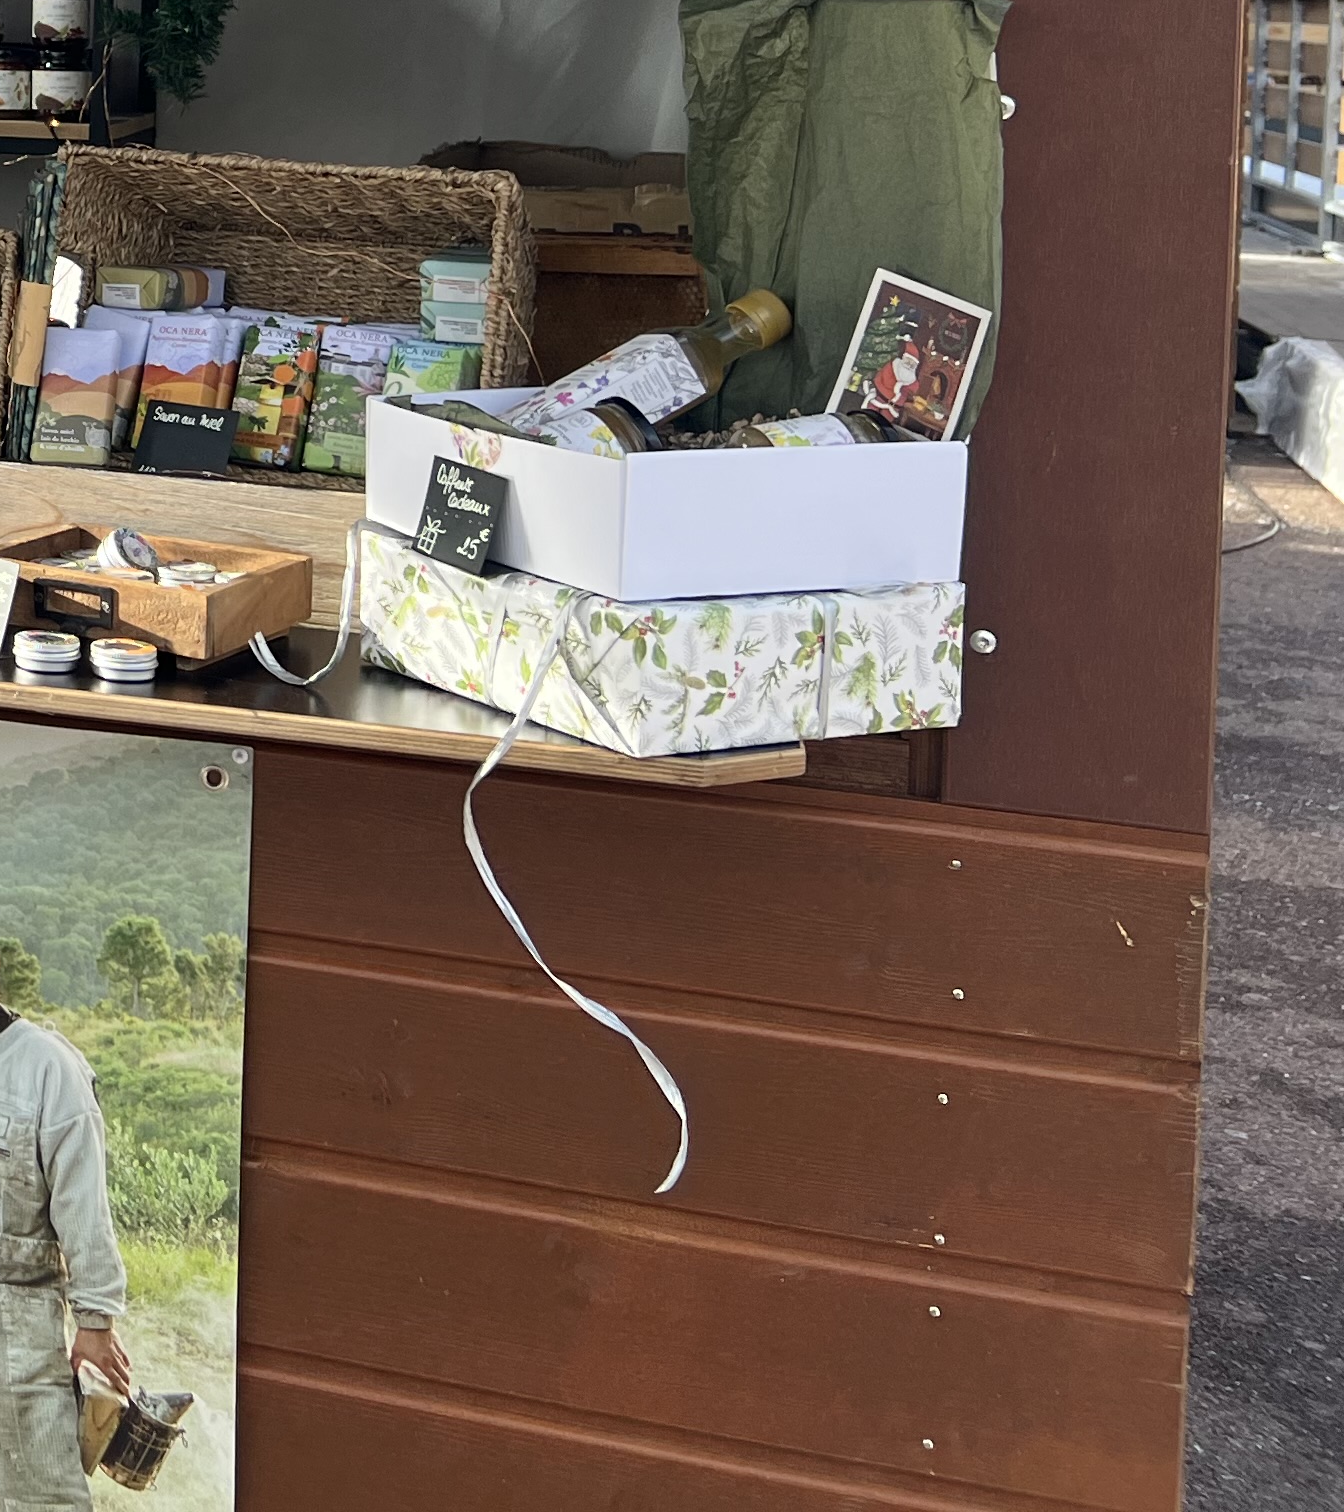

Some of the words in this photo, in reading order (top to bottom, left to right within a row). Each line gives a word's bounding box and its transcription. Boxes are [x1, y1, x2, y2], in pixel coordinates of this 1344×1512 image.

[159, 325, 180, 335] OCA
[181, 327, 208, 337] NERA
[336, 329, 357, 339] OCA
[360, 332, 389, 344] NERA
[397, 346, 418, 356] OCA
[421, 349, 451, 359] NERA
